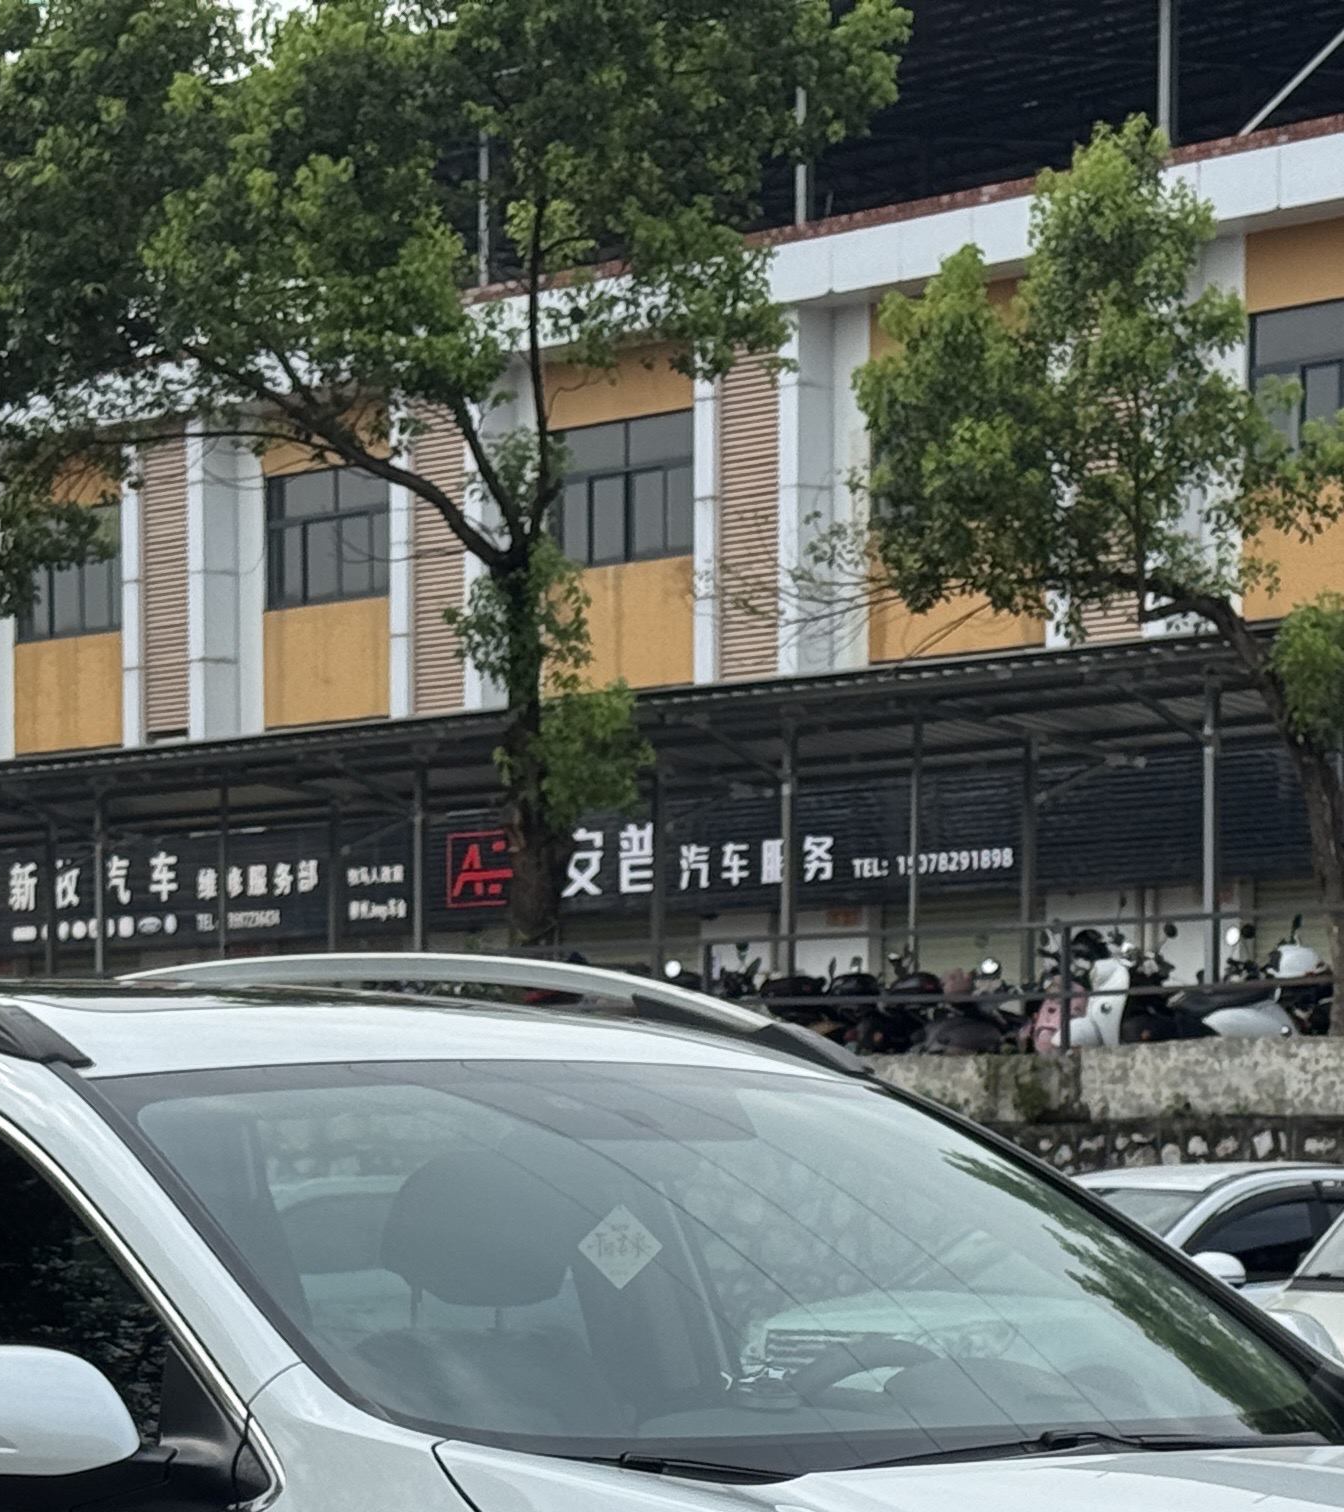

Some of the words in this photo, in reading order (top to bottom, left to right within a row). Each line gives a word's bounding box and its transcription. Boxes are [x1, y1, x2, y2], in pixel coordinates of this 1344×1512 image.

[679, 834, 835, 890] 汽车服务
[853, 857, 888, 879] TEL:
